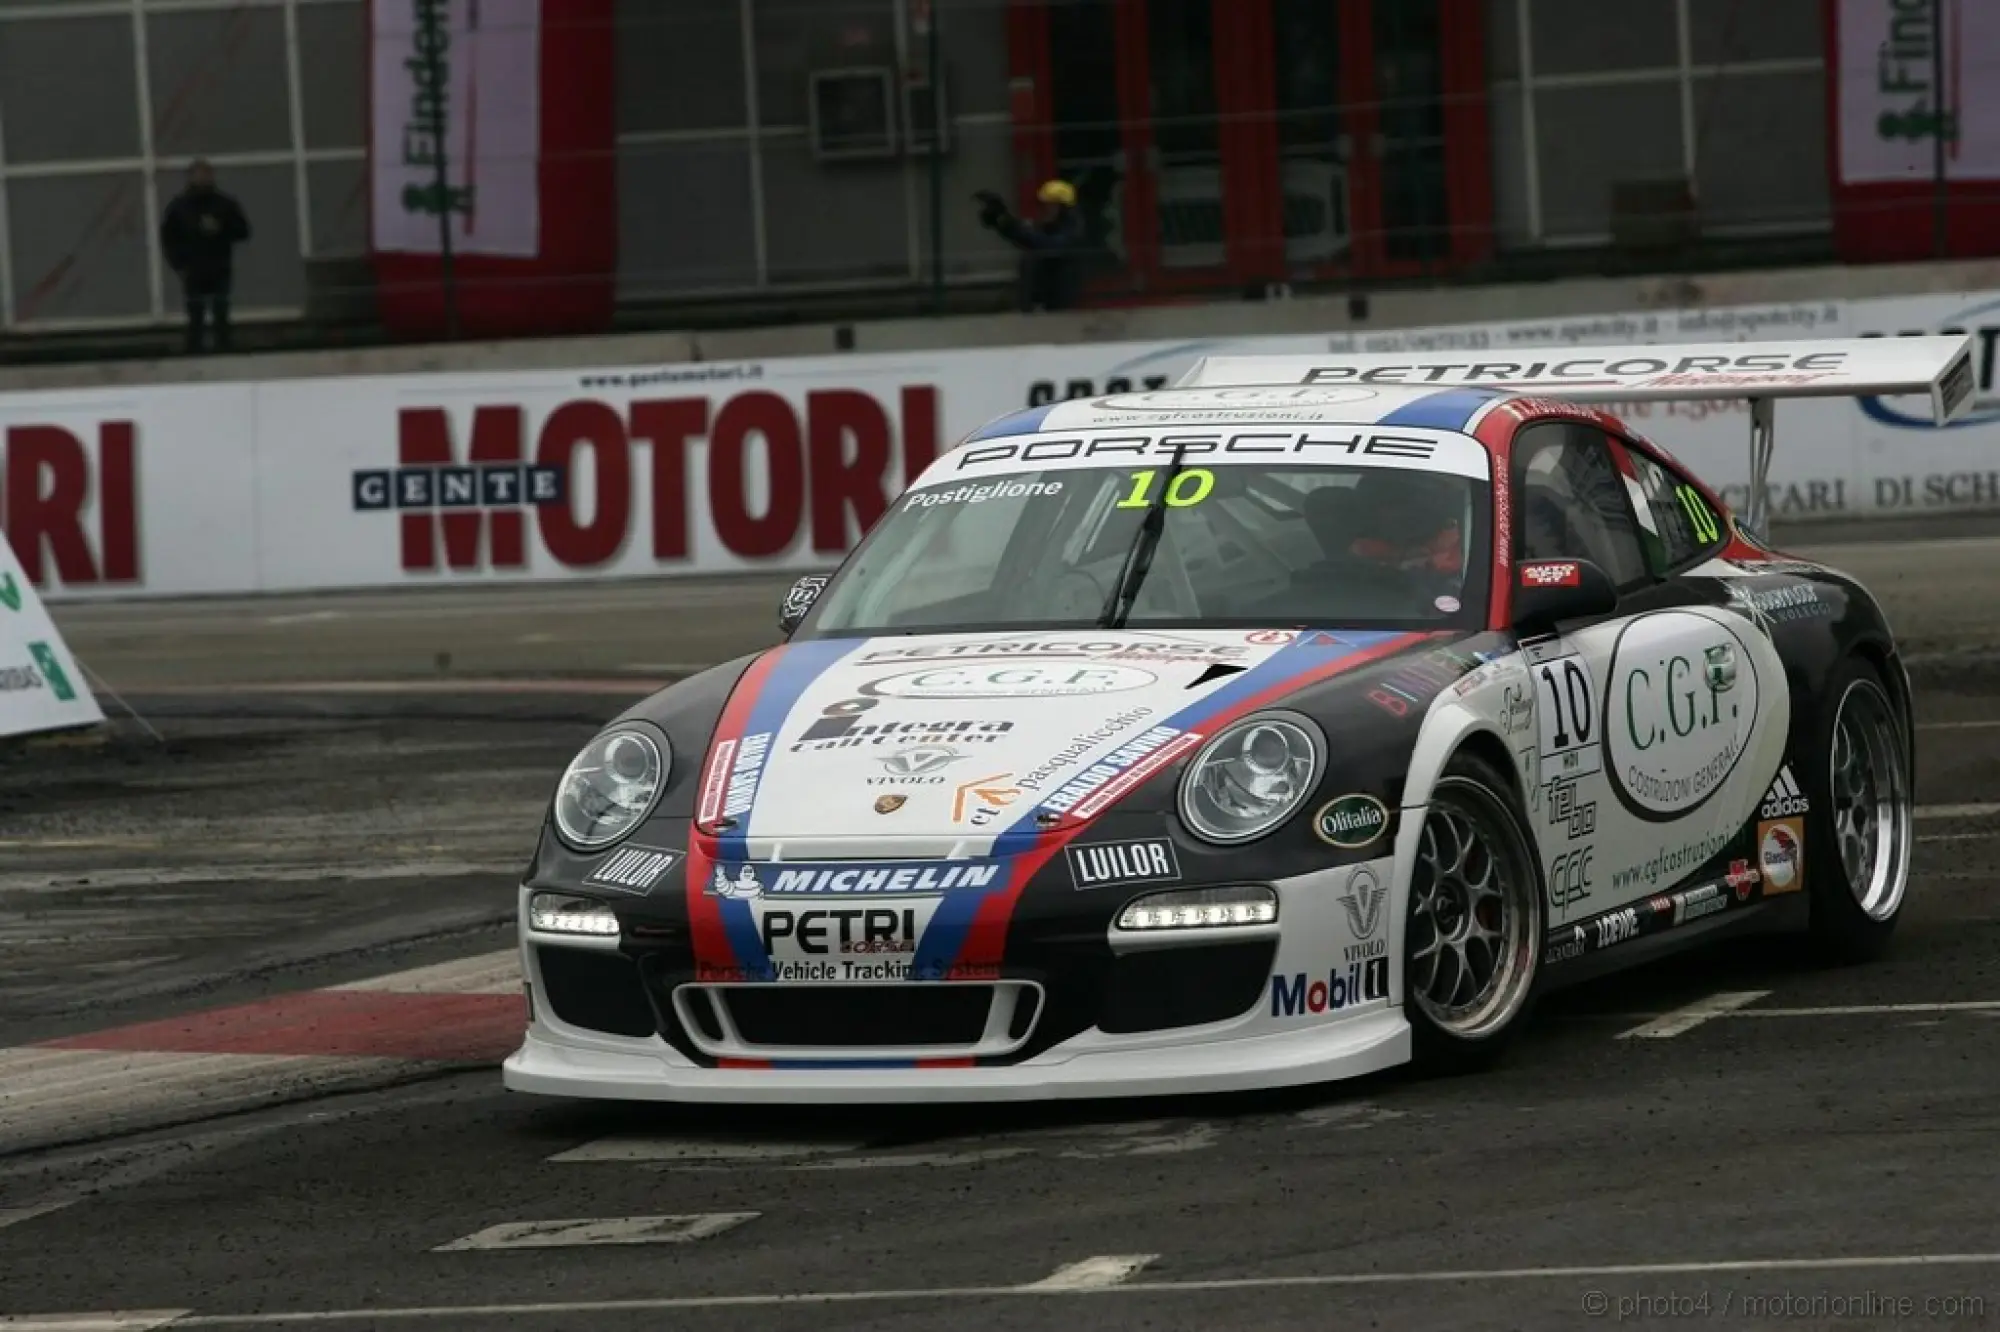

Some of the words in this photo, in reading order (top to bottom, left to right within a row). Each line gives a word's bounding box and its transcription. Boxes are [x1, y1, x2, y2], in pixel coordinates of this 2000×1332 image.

[1299, 353, 1848, 385] PETRICORSE
[957, 434, 1438, 471] PORSCHE
[359, 472, 558, 501] GENTE
[398, 384, 936, 568] MOTORI
[1116, 470, 1214, 508] 10
[1875, 474, 1913, 508] DI
[905, 480, 1063, 513] Postiglione
[860, 641, 1250, 662] PETRICORSE
[1541, 660, 1591, 749] 10
[1321, 805, 1382, 836] Olitalia
[1761, 798, 1810, 819] adidas
[593, 848, 673, 888] LUILOR
[771, 865, 1000, 893] MICHELIN
[1075, 845, 1169, 883] LUILOR
[763, 909, 915, 954] PETRI
[1344, 939, 1387, 961] VIVOLO
[699, 962, 768, 979] Porsche
[773, 960, 837, 980] Vehicle
[842, 959, 927, 984] Tracking
[932, 957, 1000, 980] System
[1271, 962, 1362, 1016] Mobil
